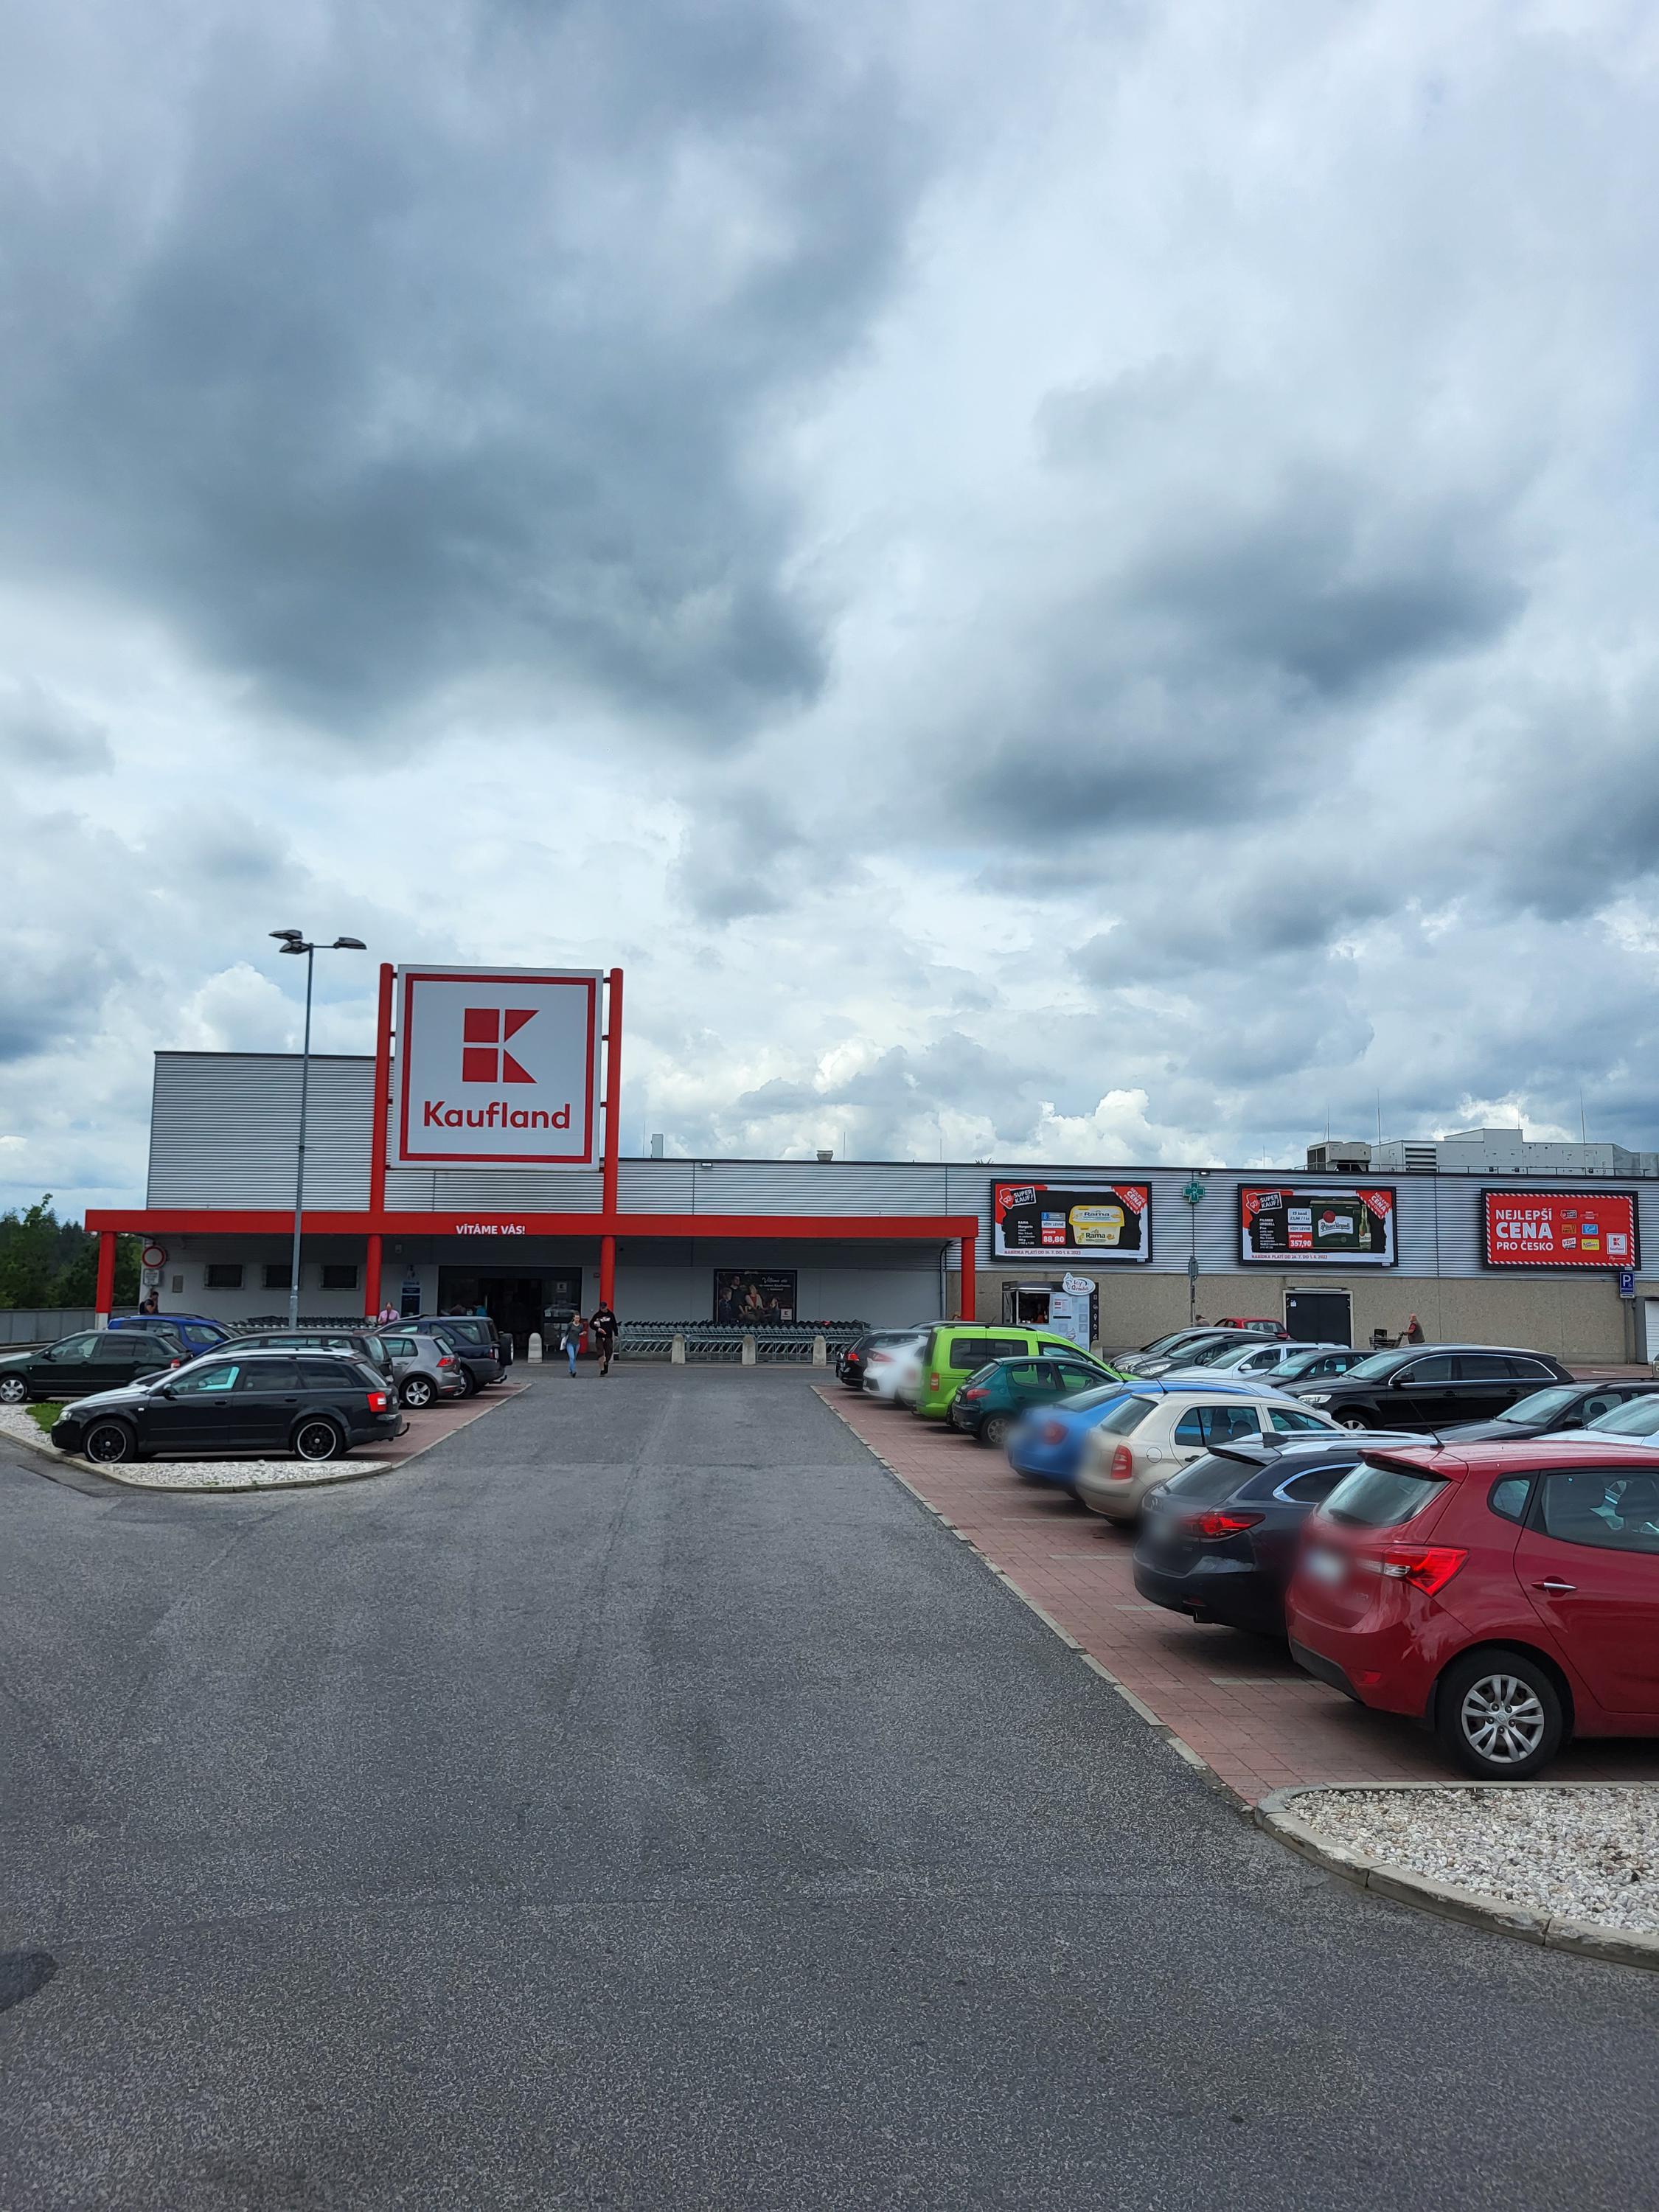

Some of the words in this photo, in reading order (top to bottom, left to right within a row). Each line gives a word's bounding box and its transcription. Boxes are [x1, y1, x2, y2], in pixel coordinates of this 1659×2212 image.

[423, 1100, 571, 1130] Kaufland
[1013, 1189, 1033, 1198] SUPER
[1015, 1194, 1033, 1203] KAUF!
[1127, 1190, 1142, 1207] CENA
[1259, 1194, 1279, 1203] SUPER
[1262, 1199, 1279, 1208] KAUF!
[1371, 1195, 1386, 1212] CENA
[1495, 1208, 1552, 1221] NEJLEPŠÍ
[456, 1223, 498, 1234] VÍTÁME
[501, 1224, 525, 1234] VÁS!
[1496, 1222, 1554, 1239] CENA
[1043, 1236, 1065, 1244] 88,80
[1496, 1242, 1518, 1251] PRO
[1520, 1239, 1554, 1251] ČESKO
[1622, 1274, 1631, 1287] P
